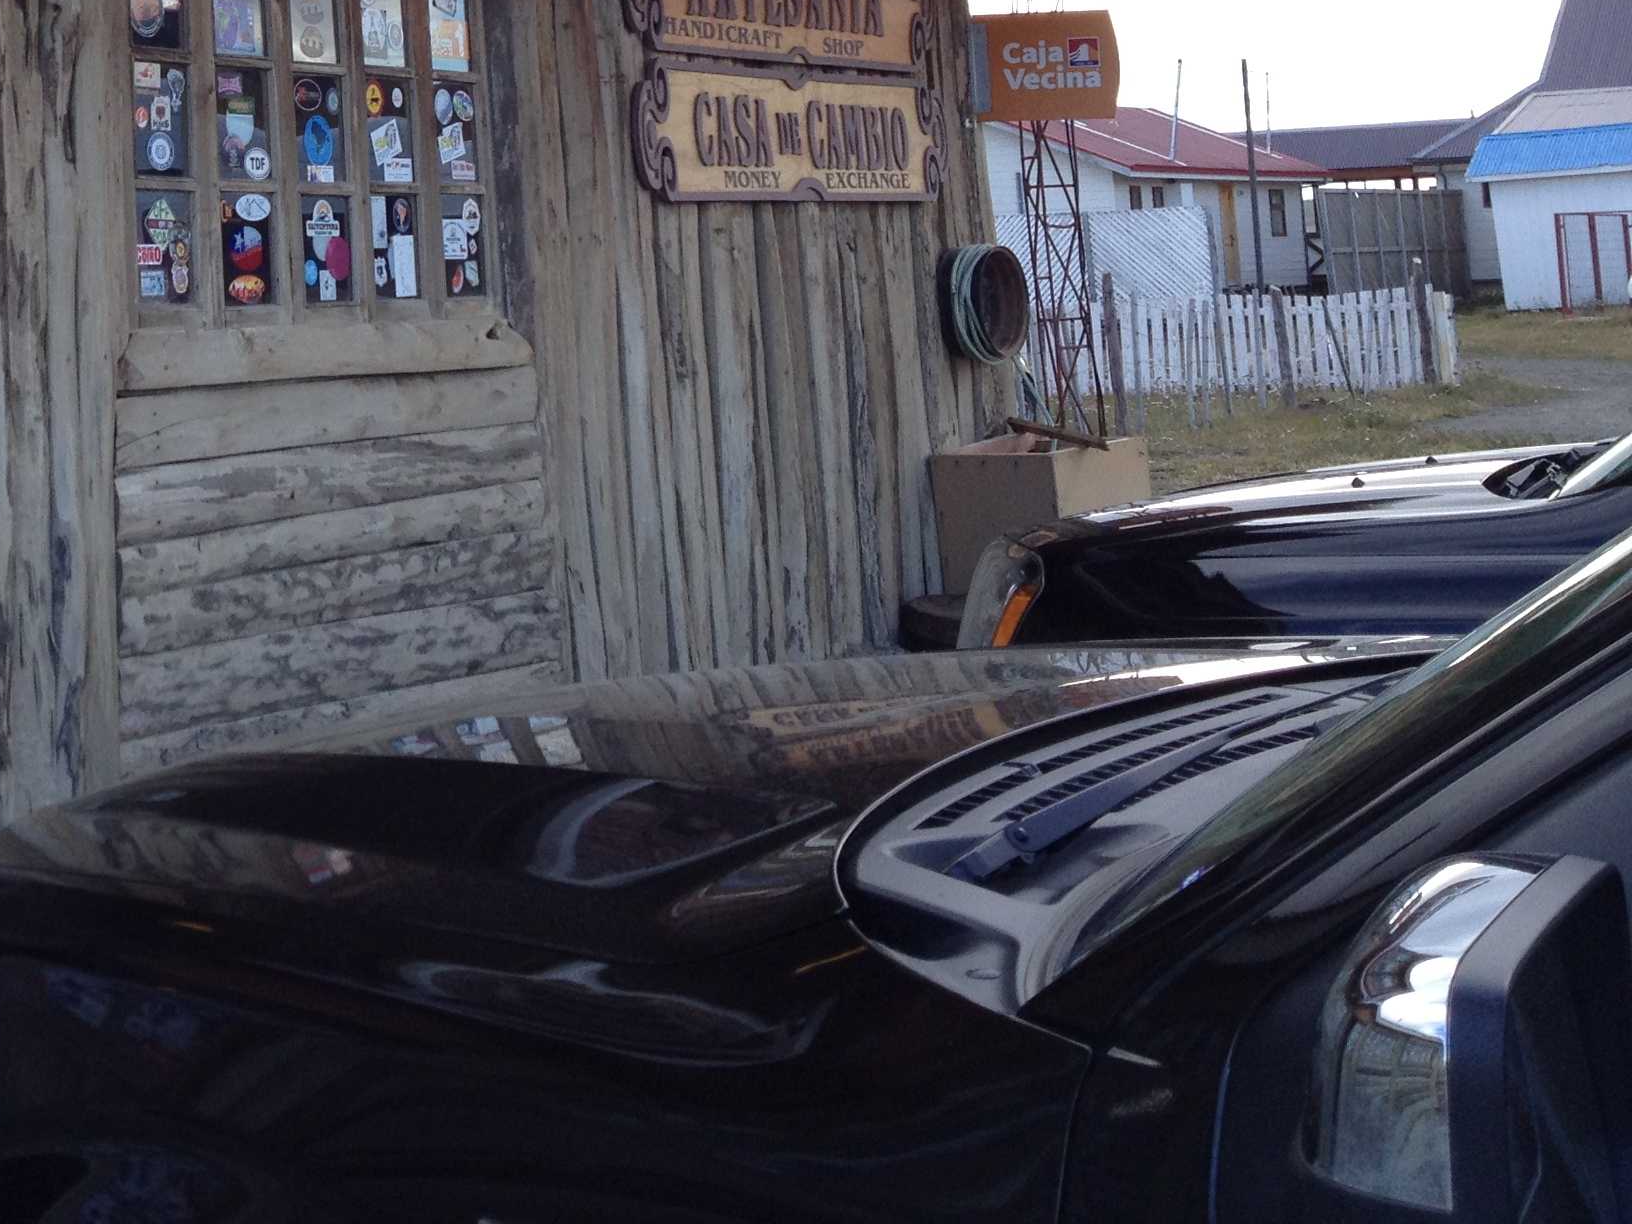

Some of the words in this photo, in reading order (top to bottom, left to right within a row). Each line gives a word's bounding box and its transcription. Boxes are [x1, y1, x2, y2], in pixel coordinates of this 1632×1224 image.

[665, 17, 782, 49] HANDICRAFT
[823, 37, 864, 56] SHOP
[1002, 40, 1063, 69] Caja
[1003, 66, 1102, 90] Vecina
[694, 92, 774, 168] CASA
[776, 112, 801, 155] DE
[807, 100, 908, 171] CAMBIO
[250, 157, 265, 170] TDF
[724, 171, 781, 189] MONEY
[826, 172, 910, 189] EXCHANGE
